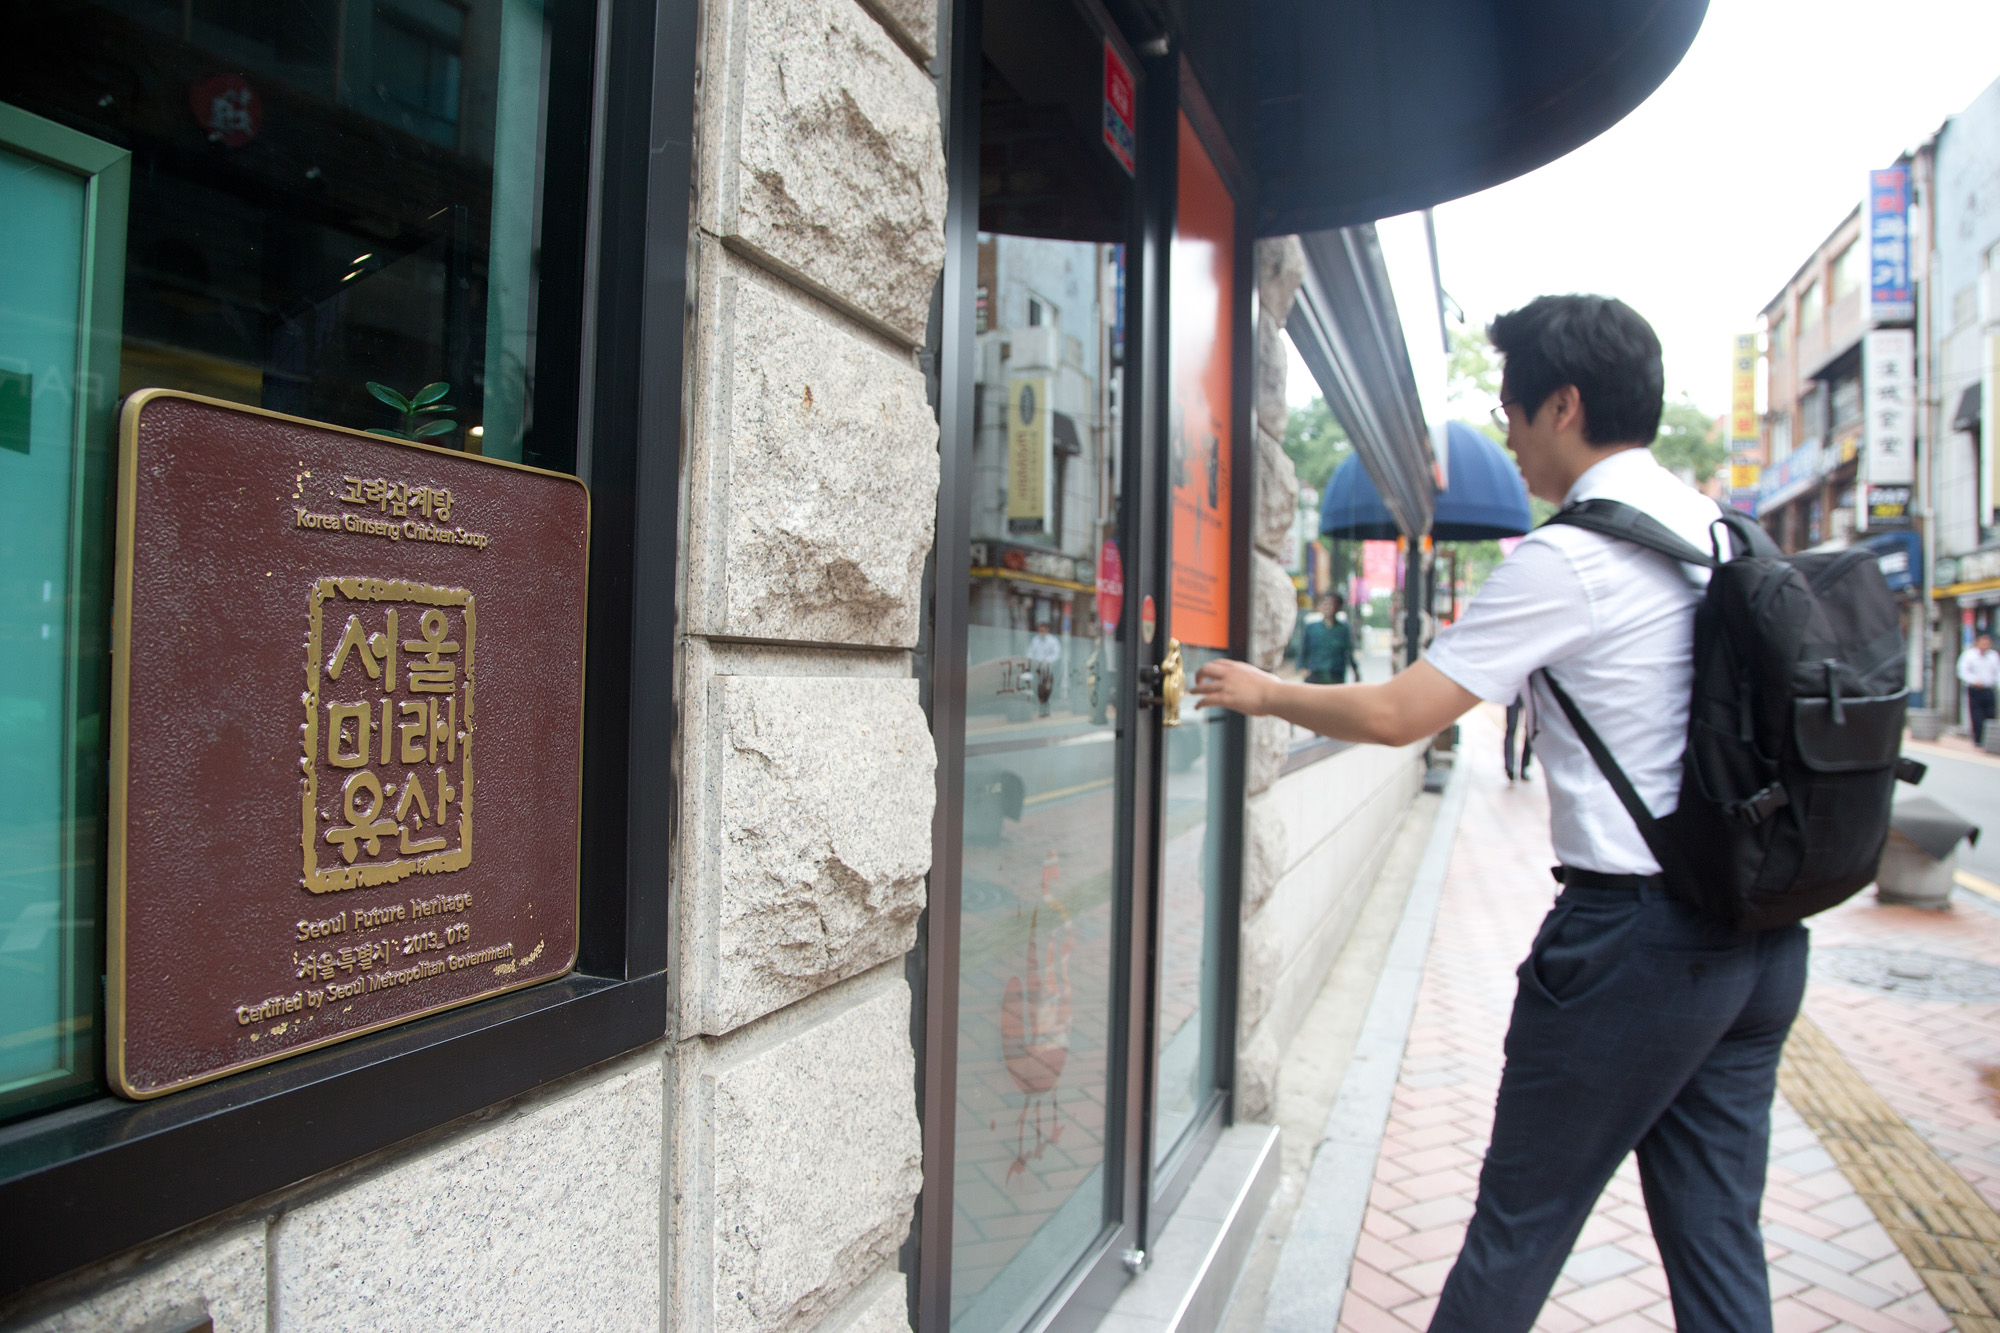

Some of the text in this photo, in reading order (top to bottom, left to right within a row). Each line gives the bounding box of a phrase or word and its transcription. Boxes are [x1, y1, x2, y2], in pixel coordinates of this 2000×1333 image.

[339, 475, 455, 522] 고려삼계탕
[295, 507, 488, 550] Korea Ginseng Chicken Soup
[328, 609, 460, 693] 서울
[327, 697, 456, 768] 미래
[325, 768, 456, 863] 유산
[296, 893, 473, 941] Seoul Future Heritage
[236, 943, 513, 1025] Certified by Seoul Metropolitan Government
[296, 939, 390, 982] 서울특별시
